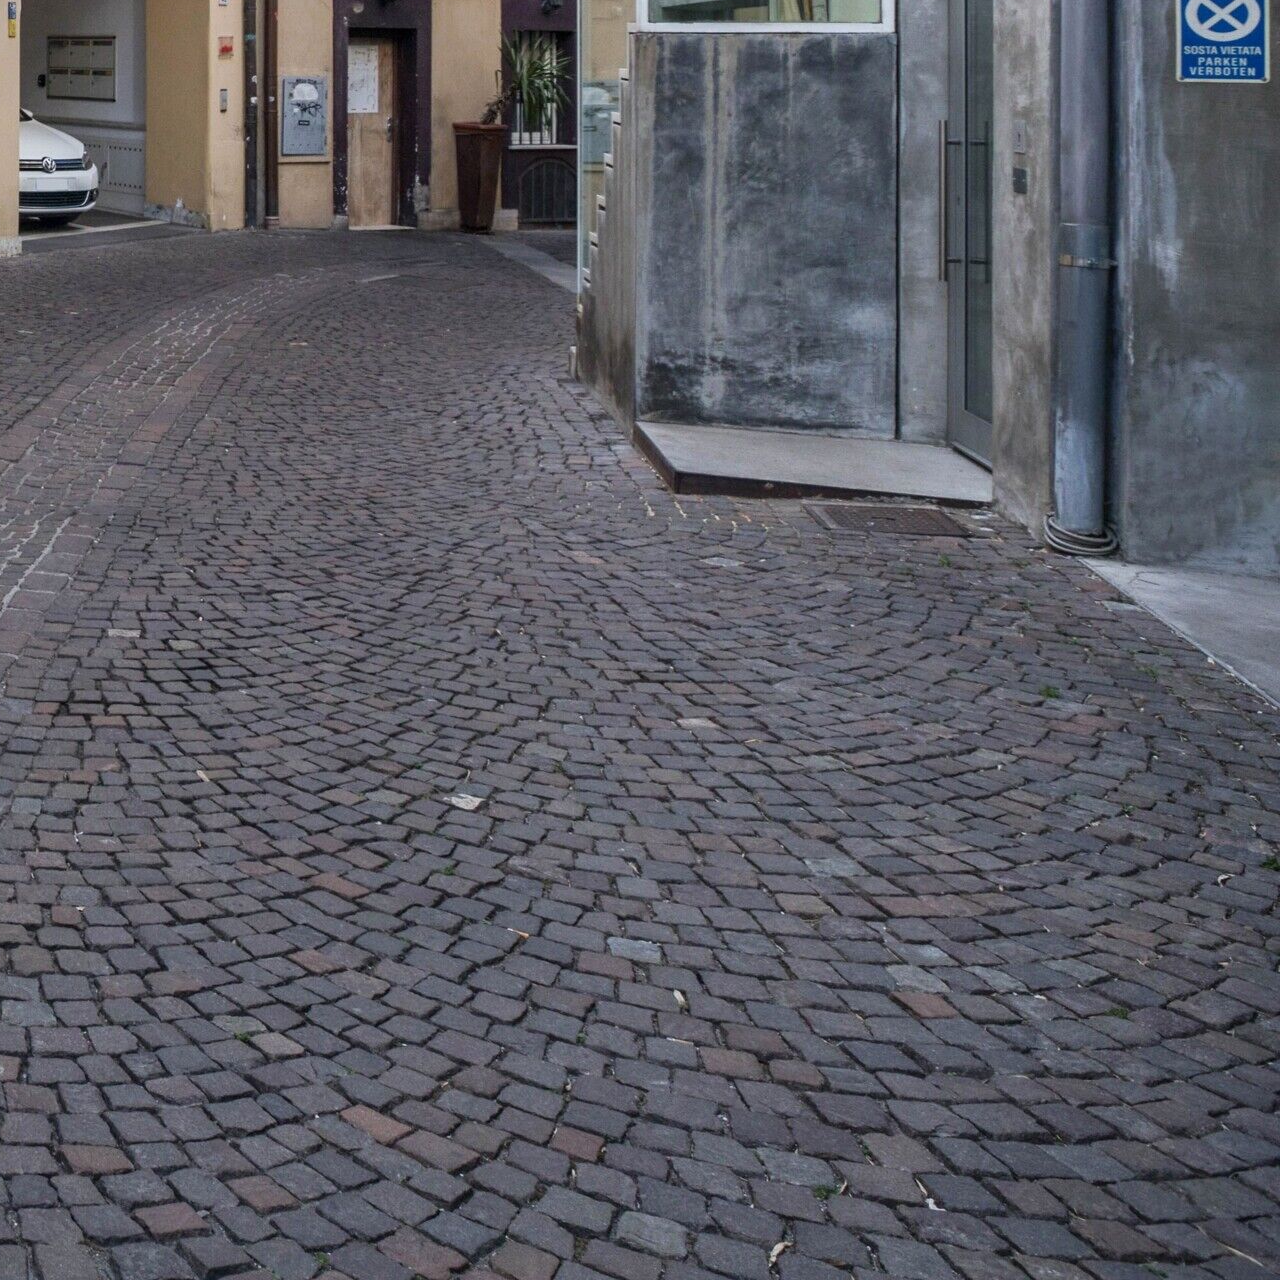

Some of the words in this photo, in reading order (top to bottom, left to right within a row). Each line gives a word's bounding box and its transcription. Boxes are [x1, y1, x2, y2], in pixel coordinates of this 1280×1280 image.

[1183, 45, 1218, 55] SOSTA
[1220, 45, 1262, 56] VIETATA
[1197, 56, 1248, 67] PARKEN
[1188, 66, 1257, 77] VERBOTEN
